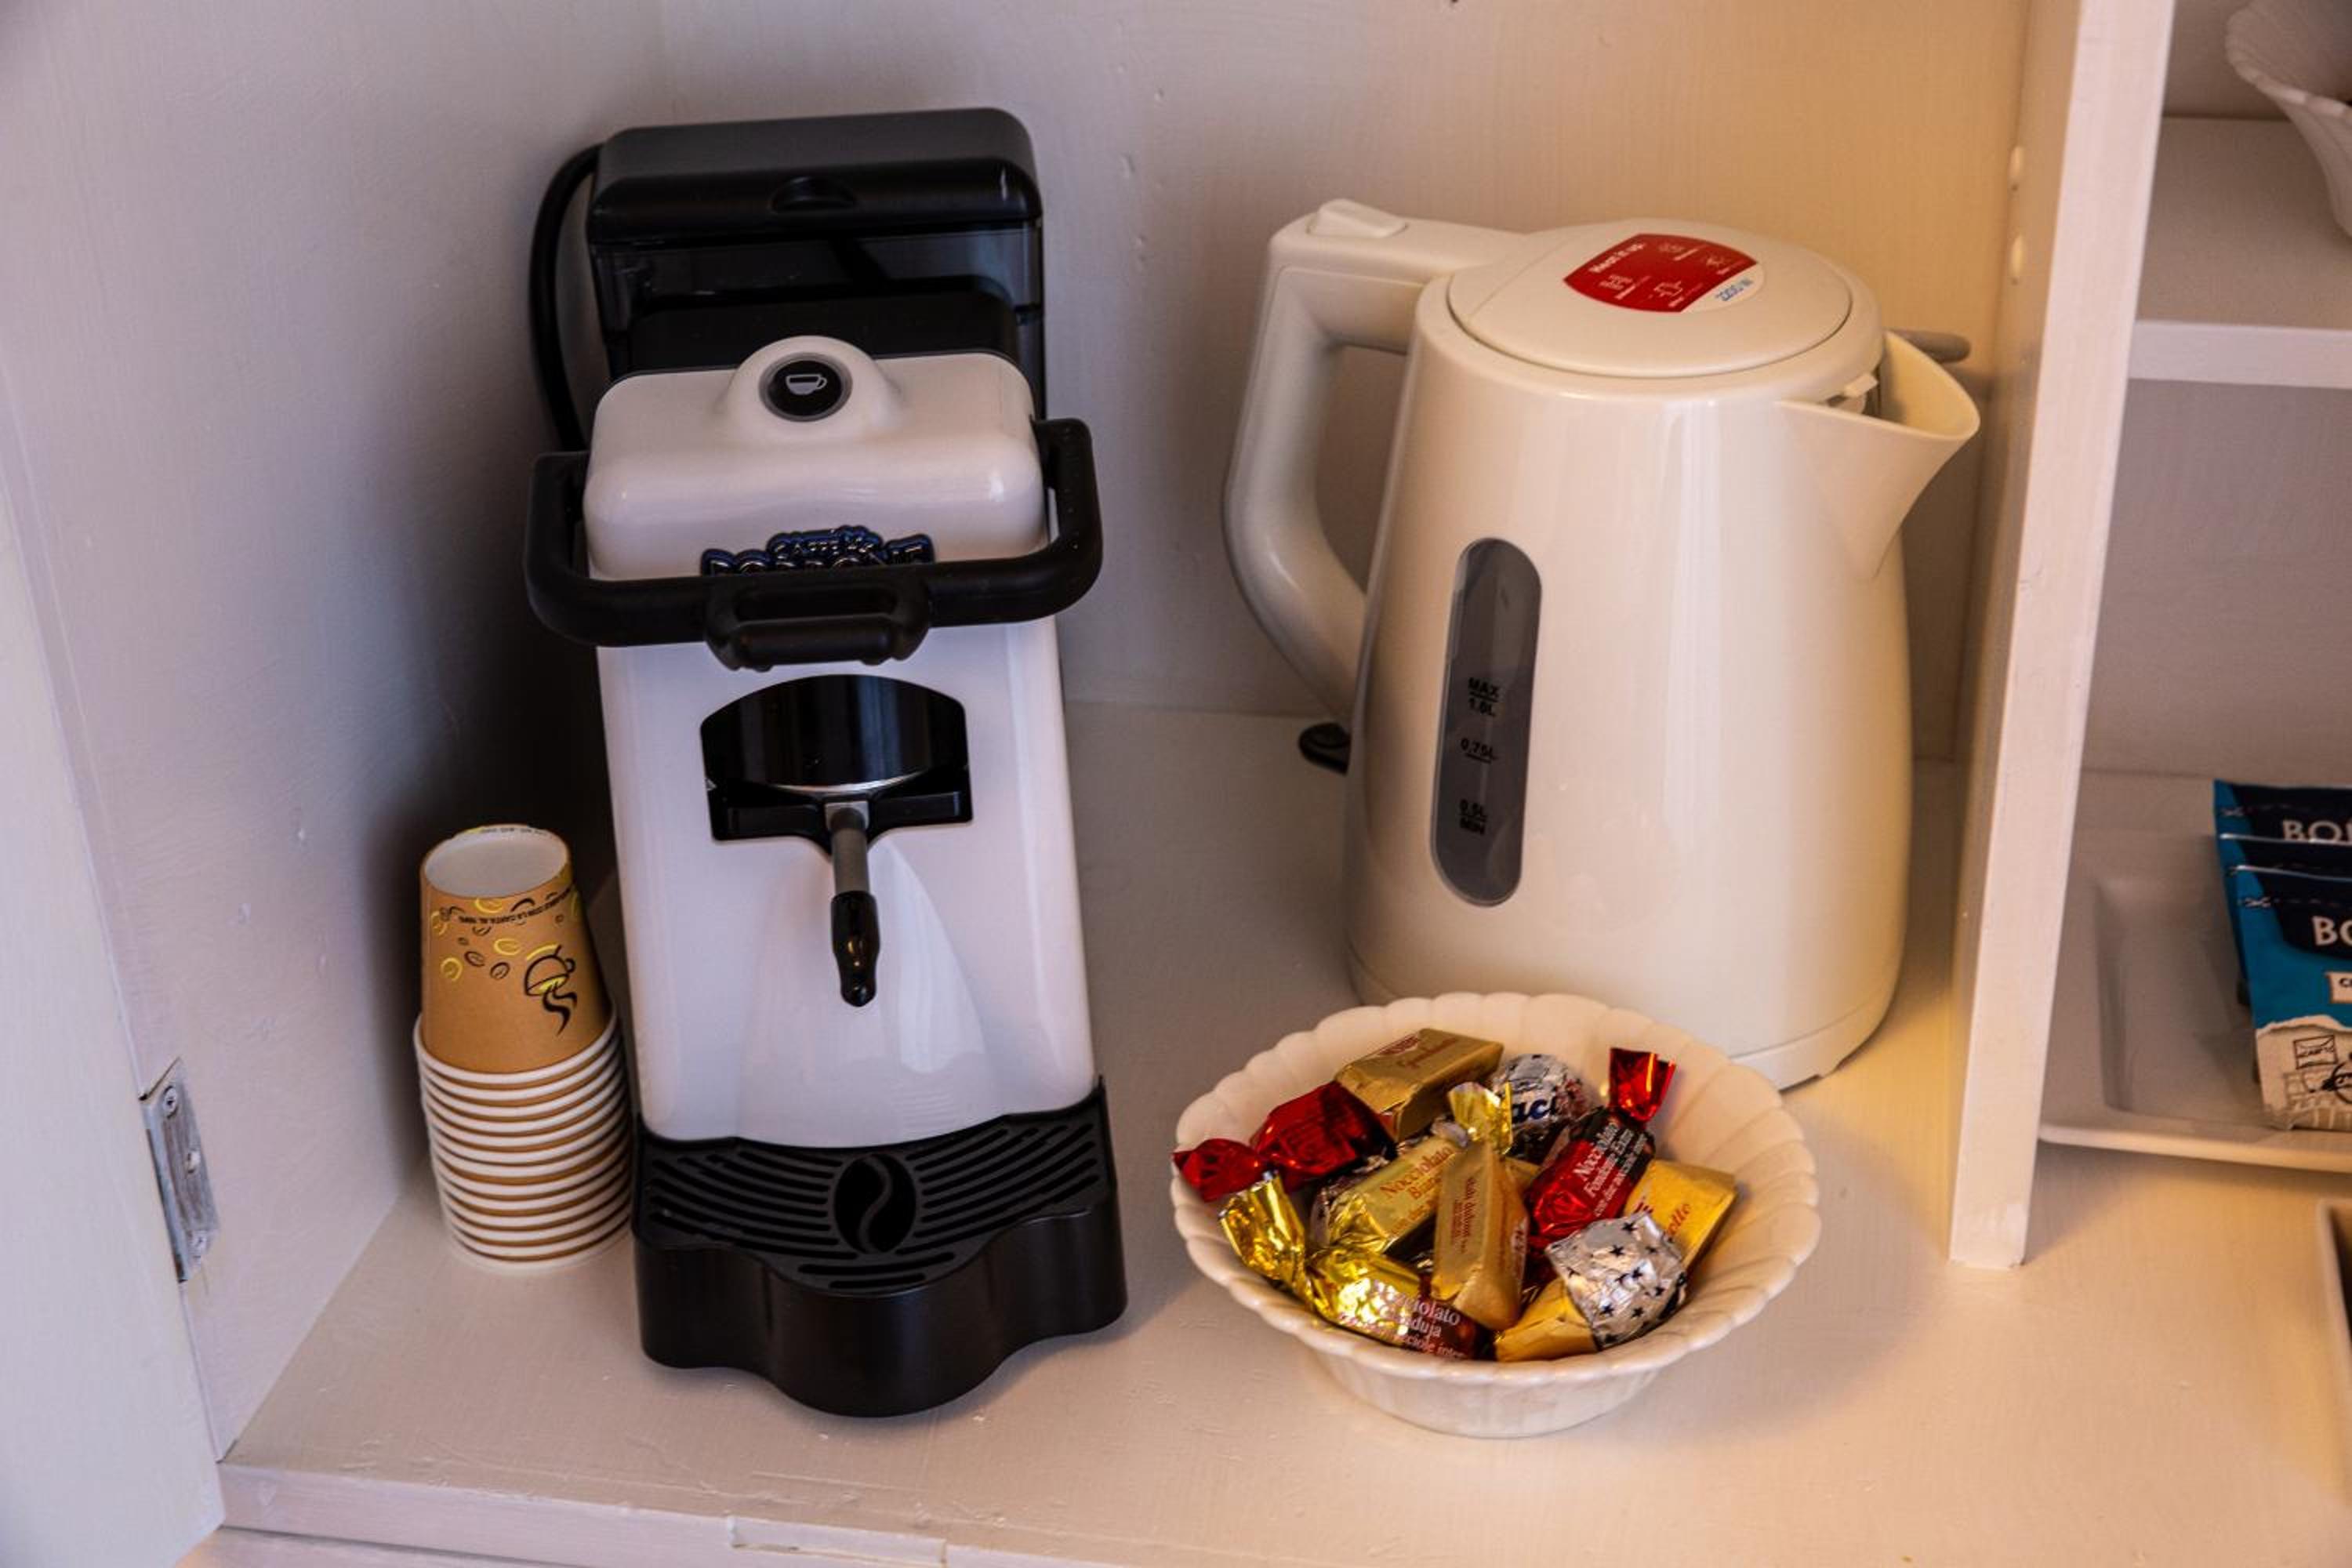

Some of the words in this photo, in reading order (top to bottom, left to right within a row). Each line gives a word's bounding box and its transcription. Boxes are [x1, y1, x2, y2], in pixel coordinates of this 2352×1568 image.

[1468, 677, 1500, 699] MAX
[2282, 820, 2352, 843] BO
[1572, 1123, 1620, 1181] Nocciolato
[1380, 1146, 1454, 1196] Nocciolato
